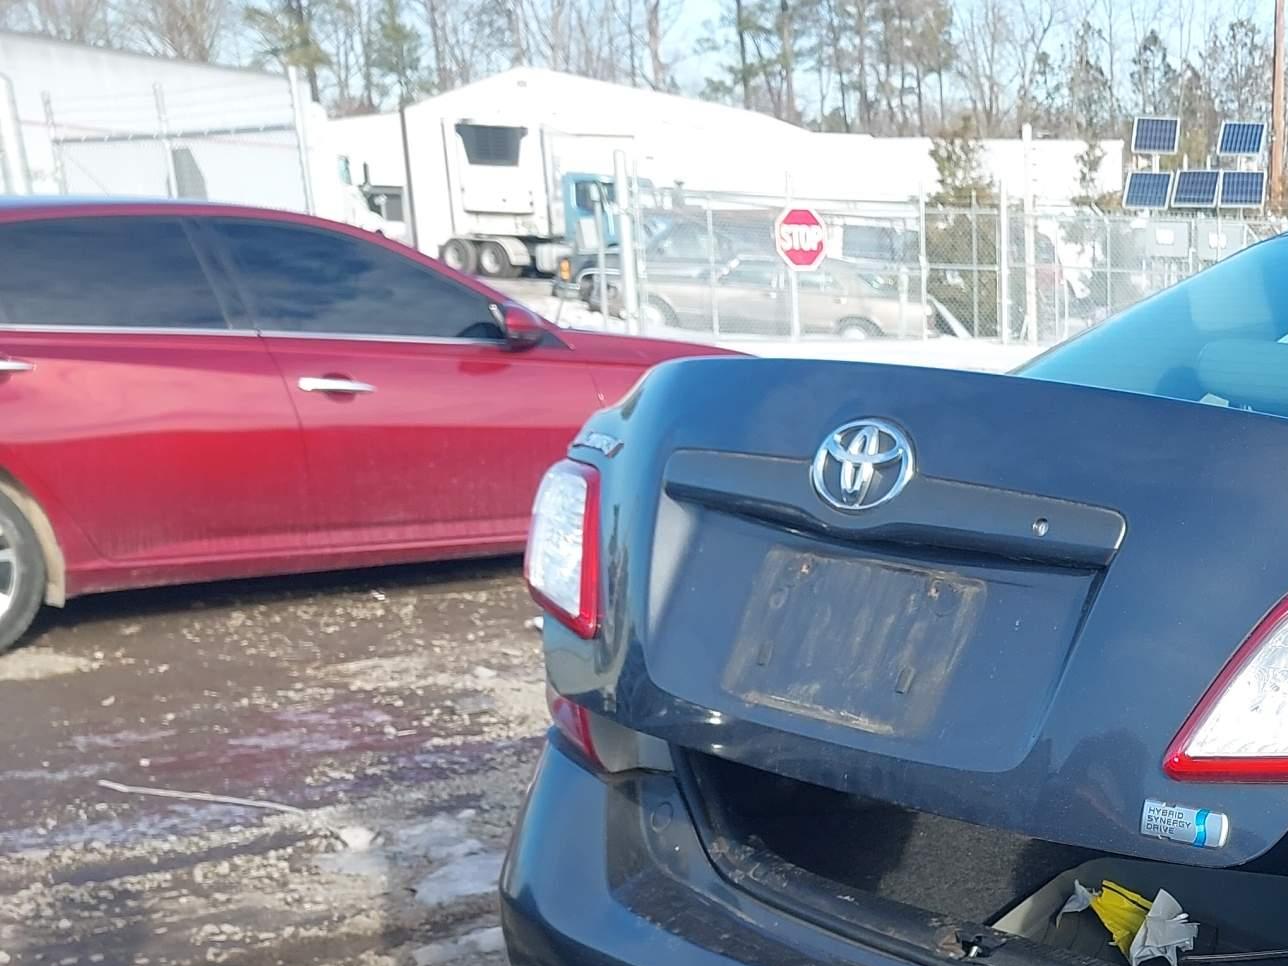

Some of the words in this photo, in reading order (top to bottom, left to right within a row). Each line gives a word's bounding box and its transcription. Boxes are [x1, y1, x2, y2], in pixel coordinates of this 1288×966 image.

[780, 223, 823, 252] STOP
[1148, 807, 1184, 820] HYBRID
[1146, 822, 1175, 835] DRIVE
[1147, 814, 1191, 829] SYNERGY
